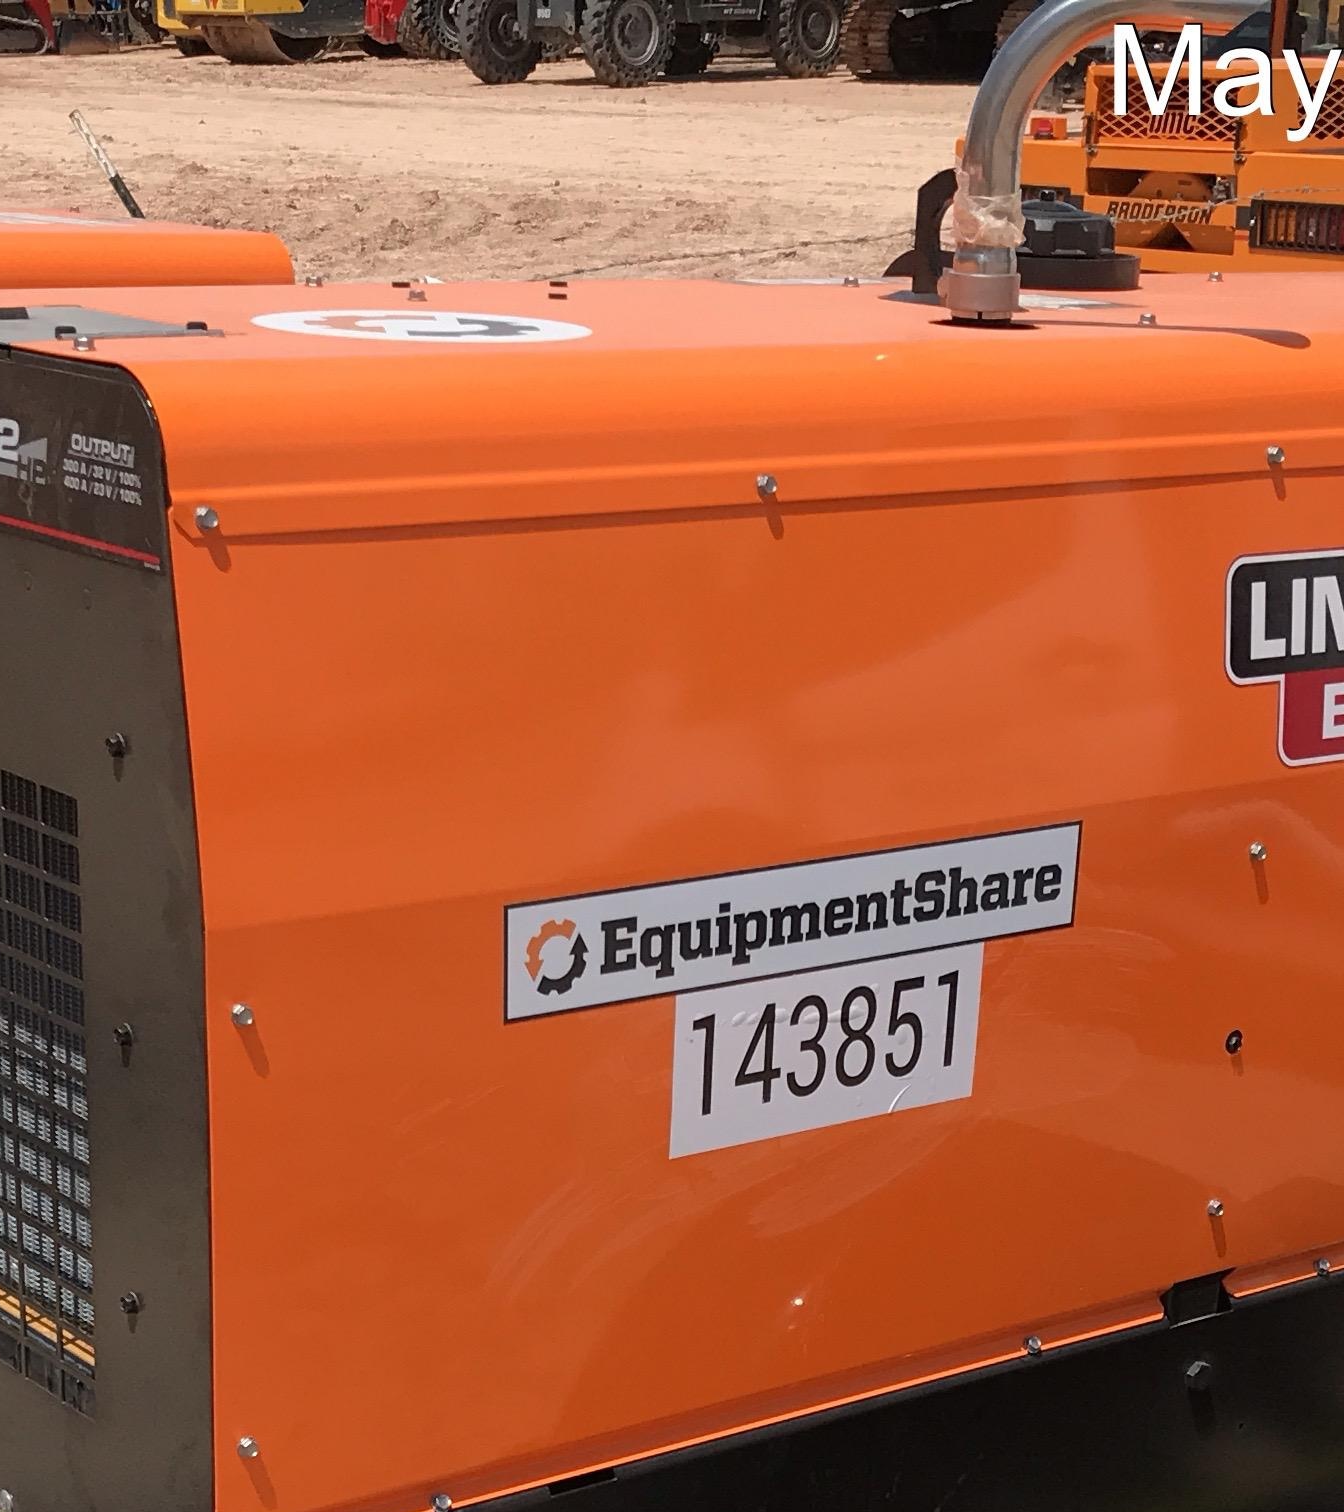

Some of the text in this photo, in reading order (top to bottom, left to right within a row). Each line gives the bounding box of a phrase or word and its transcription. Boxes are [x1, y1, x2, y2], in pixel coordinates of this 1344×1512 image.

[71, 433, 130, 461] OUTPUT
[599, 862, 1062, 979] EquipmentShare
[692, 969, 961, 1116] 143851
